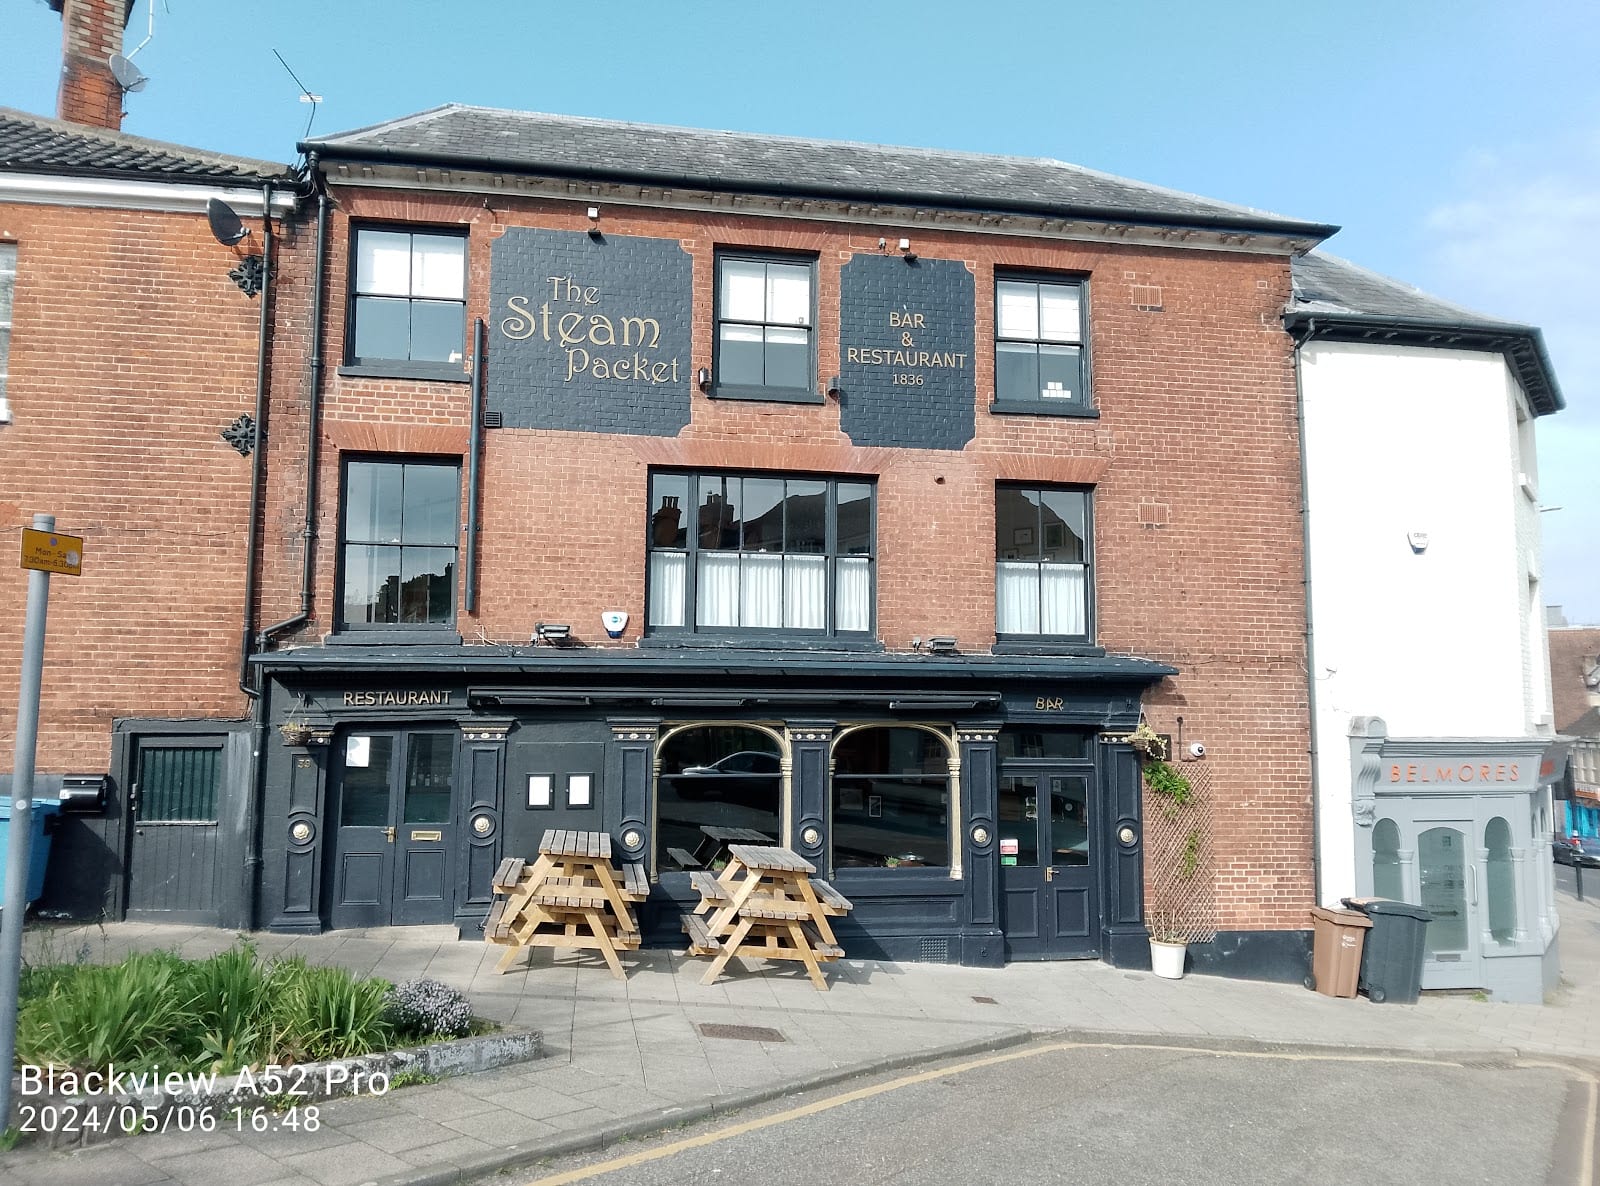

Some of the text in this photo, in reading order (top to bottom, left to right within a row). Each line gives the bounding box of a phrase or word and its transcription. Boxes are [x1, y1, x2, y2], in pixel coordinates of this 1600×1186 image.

[546, 276, 600, 306] The
[501, 296, 660, 348] Steam
[889, 311, 926, 329] BAR
[901, 331, 915, 348] &
[564, 348, 679, 385] Packet
[847, 347, 968, 369] RESTAURANT
[892, 373, 924, 386] 1836
[57, 550, 67, 559] Sa
[343, 690, 452, 705] RESTAURANT
[1035, 696, 1063, 711] BAR
[1391, 764, 1520, 782] BELMORES
